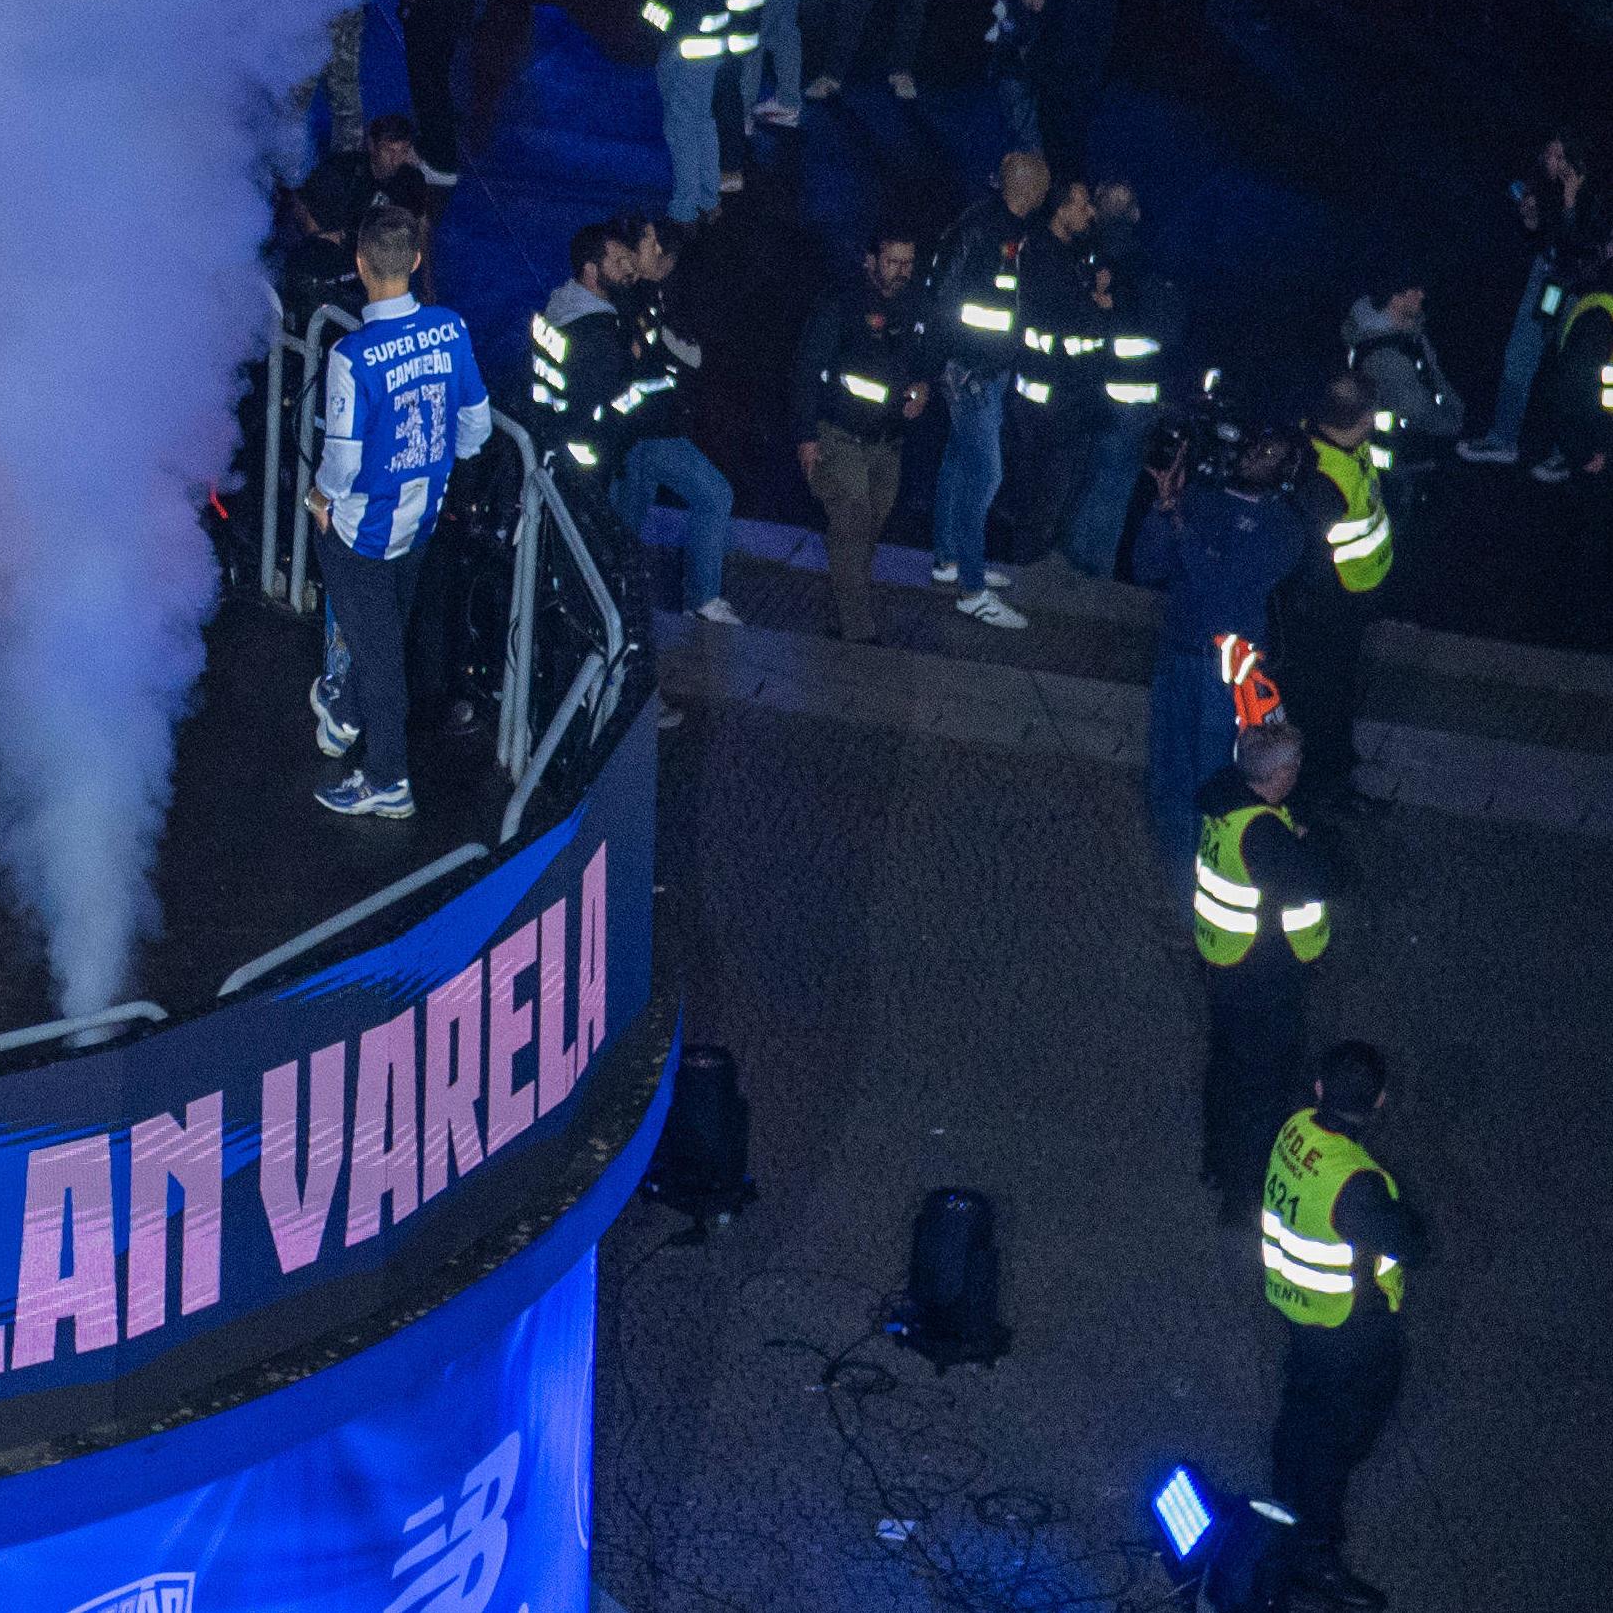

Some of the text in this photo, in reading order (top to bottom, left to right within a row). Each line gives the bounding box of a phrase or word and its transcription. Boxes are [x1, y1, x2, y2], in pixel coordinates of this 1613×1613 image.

[364, 320, 461, 369] SUPER BOCK
[259, 839, 610, 1276] VARELA
